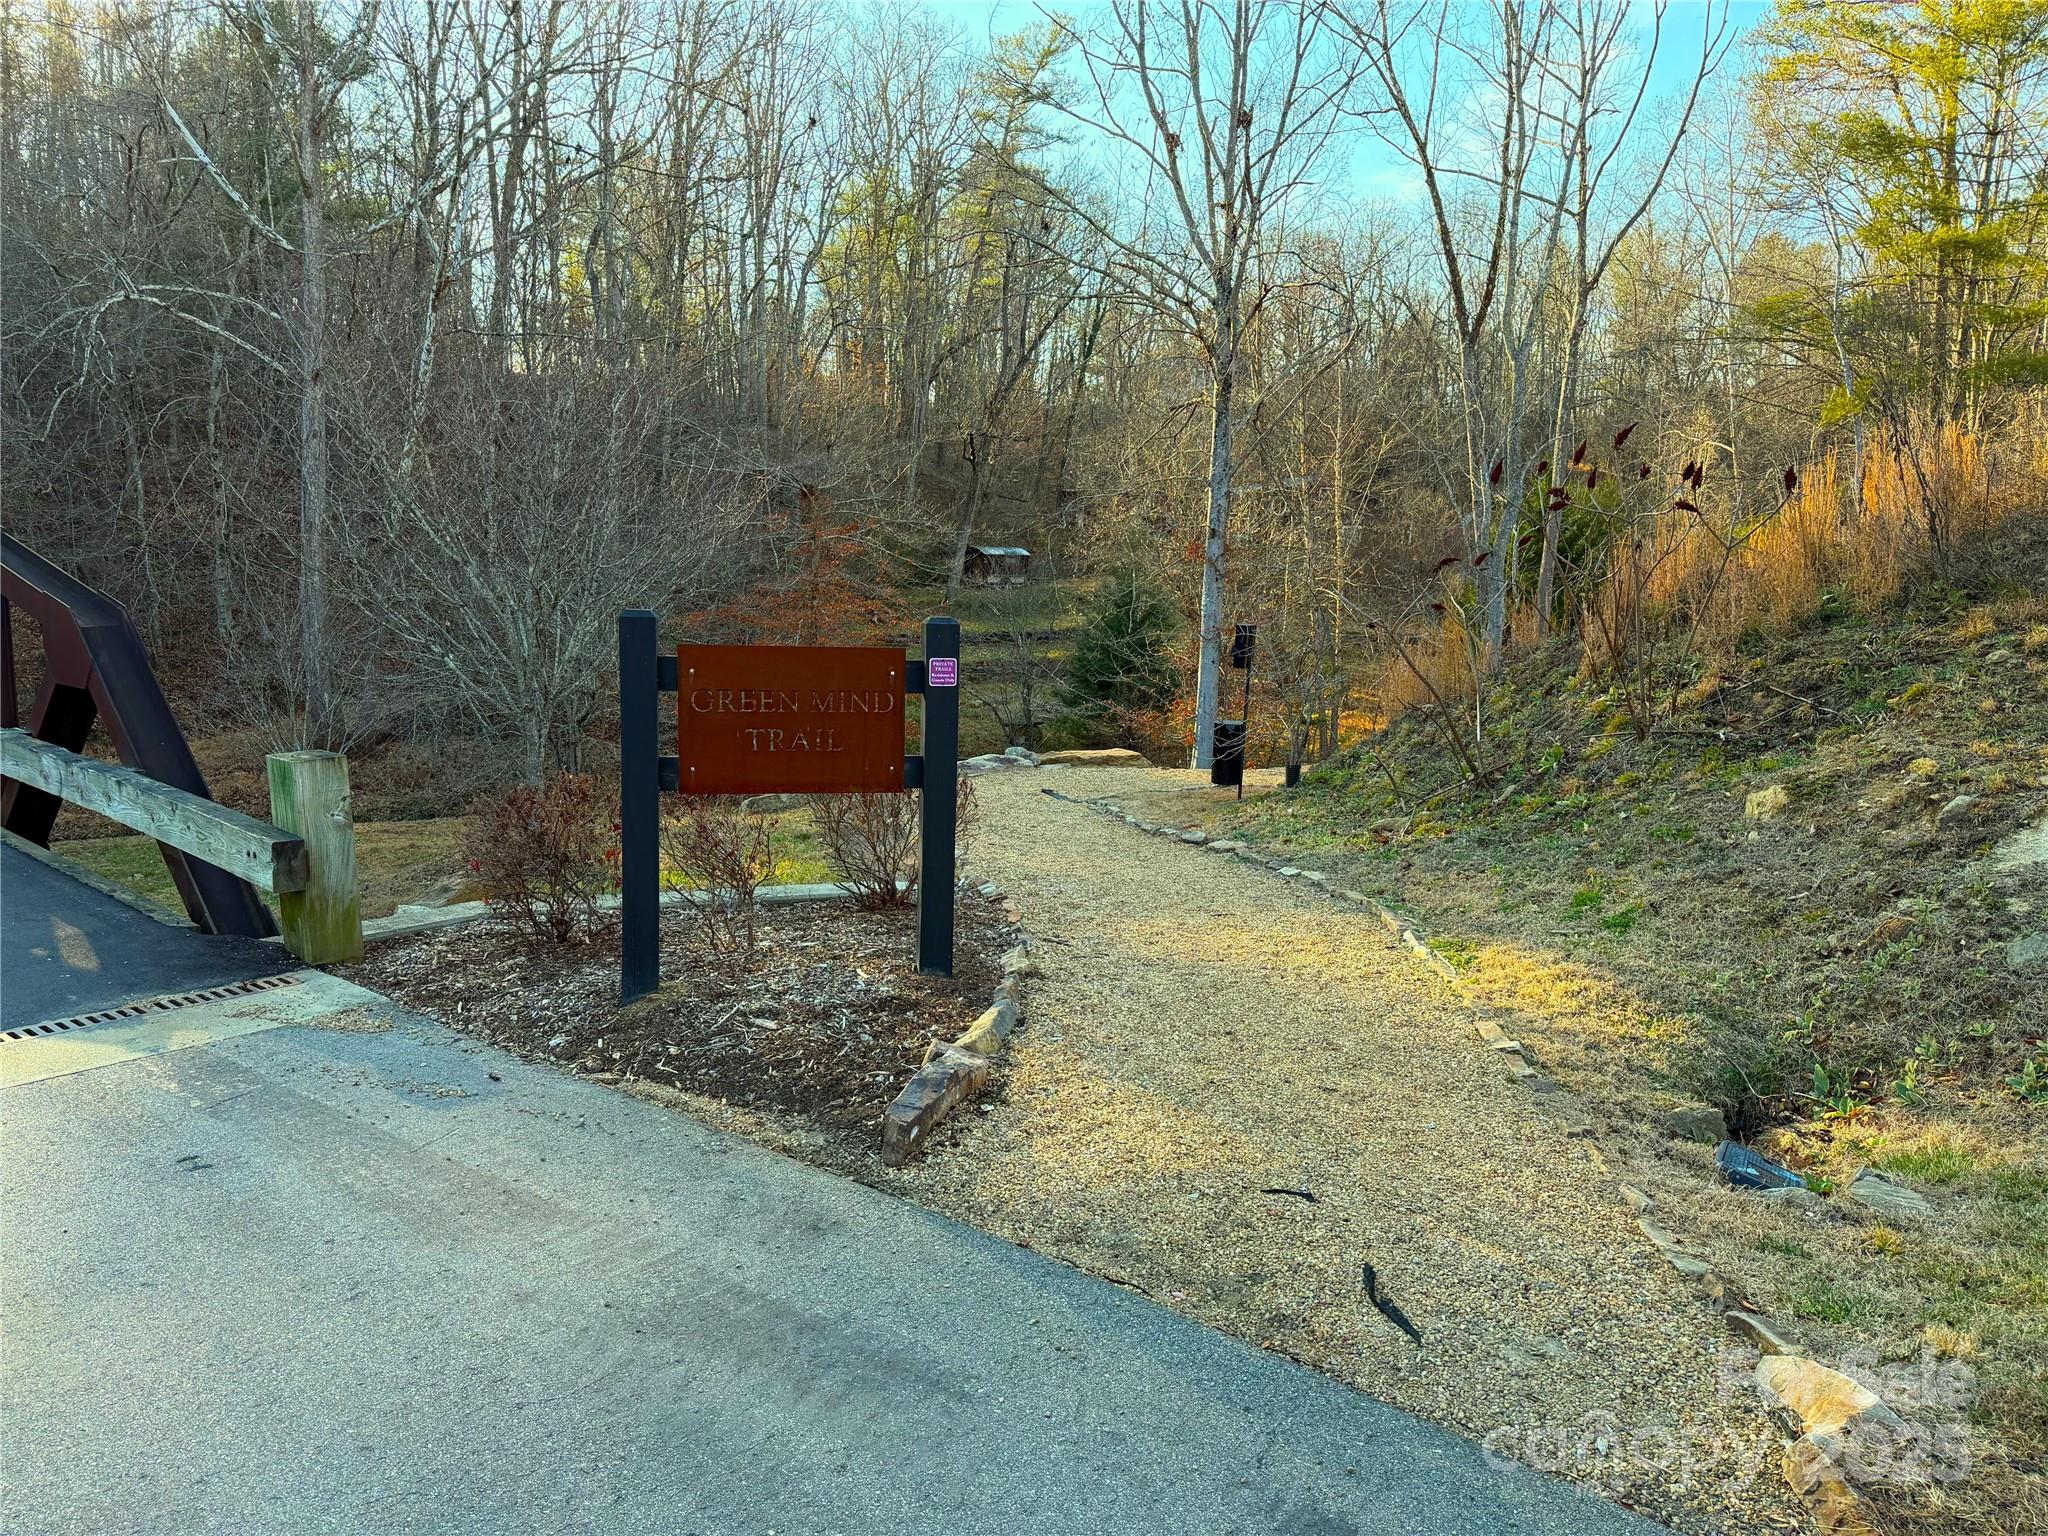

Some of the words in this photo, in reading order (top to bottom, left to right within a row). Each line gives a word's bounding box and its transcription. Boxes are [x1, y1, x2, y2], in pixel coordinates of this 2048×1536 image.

[690, 689, 798, 713] GREEN
[811, 691, 894, 713] MIND
[745, 728, 844, 752] TRAIL
